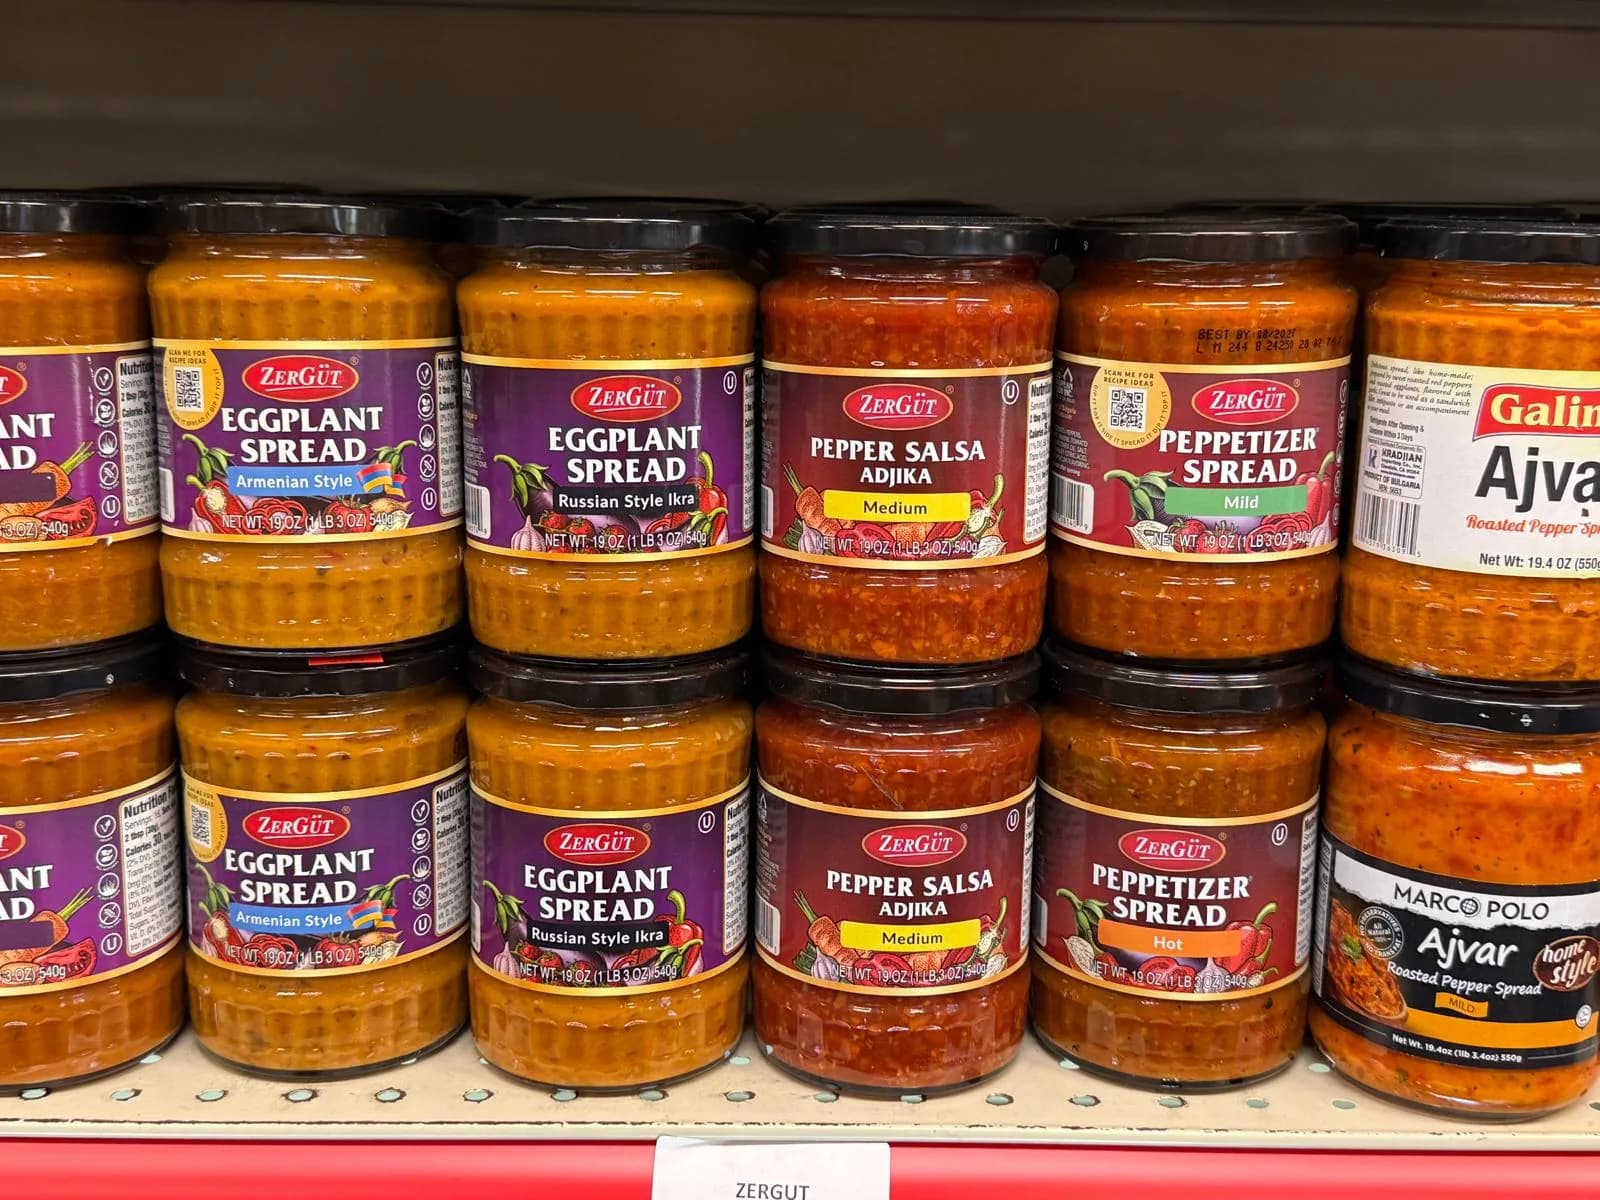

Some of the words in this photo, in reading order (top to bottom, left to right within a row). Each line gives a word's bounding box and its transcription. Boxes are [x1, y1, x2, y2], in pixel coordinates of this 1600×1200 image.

[1198, 329, 1229, 340] BEST
[1237, 330, 1250, 340] BY
[260, 364, 342, 386] ZERGÜT
[1104, 377, 1127, 385] RECIPE
[589, 384, 666, 406] ZERGÜT
[859, 393, 937, 415] ZERGÜT
[1210, 387, 1285, 409] ZERGÜT
[222, 407, 383, 433] EGGPLANT
[548, 426, 701, 452] EGGPLANT
[811, 437, 895, 462] PEPPER
[905, 440, 985, 462] SALSA
[1159, 428, 1317, 453] PEPPETIZER
[240, 438, 366, 463] SPREAD
[1382, 448, 1423, 462] KRADJIAN
[568, 457, 686, 483] SPREAD
[860, 467, 932, 488] ADJIKA
[1184, 458, 1297, 484] SPREAD
[236, 475, 312, 488] Armenian
[316, 473, 352, 490] Style
[1391, 478, 1420, 489] BULGARIA
[558, 494, 618, 508] Russian
[624, 494, 663, 511] Style
[669, 492, 695, 506] Ikra
[864, 500, 927, 514] Medium
[1224, 495, 1259, 509] Mild
[222, 515, 243, 528] NET
[246, 516, 265, 529] WT.
[269, 516, 280, 529] 19
[284, 516, 301, 529] OZ
[304, 516, 314, 530] (1
[320, 516, 334, 529] LB
[337, 516, 344, 528] 3
[347, 514, 366, 528] OZ)
[370, 512, 392, 526] 540g
[1466, 515, 1524, 532] Roasted
[1529, 520, 1578, 537] Pepper
[545, 534, 566, 547] NET
[569, 535, 589, 548] WT.
[593, 536, 605, 548] 19
[609, 536, 624, 548] OZ
[628, 535, 636, 549] (1
[641, 535, 655, 547] LB
[657, 534, 663, 546] 3
[666, 533, 684, 546] OZ)
[686, 531, 706, 545] 540g
[815, 538, 835, 551] NET
[838, 540, 854, 552] WT.
[859, 541, 870, 553] 19
[874, 541, 889, 553] OZ
[892, 541, 902, 555] (1
[907, 541, 919, 553] LB
[922, 541, 930, 553] 3
[932, 540, 952, 554] OZ)
[955, 541, 977, 554] 540g
[1154, 533, 1175, 545] NET
[1180, 534, 1198, 547] WT.
[1204, 535, 1216, 547] 19
[1219, 535, 1234, 548] OZ
[1238, 535, 1246, 549] (1
[1251, 534, 1263, 547] LB
[1265, 533, 1272, 545] 3
[1275, 532, 1292, 545] OZ)
[1480, 553, 1500, 566] Net
[1504, 555, 1524, 568] Wt:
[1529, 557, 1552, 569] 19.4
[1556, 557, 1571, 569] OZ
[124, 791, 167, 819] Nutrition
[258, 814, 333, 835] ZERGÜT
[560, 831, 634, 850] ZERGÜT
[879, 832, 952, 852] ZERGÜT
[1135, 837, 1210, 858] ZERGÜT
[225, 848, 374, 876] EGGPLANT
[524, 864, 672, 894] EGGPLANT
[827, 870, 913, 897] PEPPER
[924, 869, 993, 895] SALSA
[1092, 864, 1249, 900] PEPPETIZER
[240, 879, 356, 905] SPREAD
[236, 911, 300, 927] Armenian
[305, 913, 342, 928] Style
[540, 897, 654, 922] SPREAD
[879, 901, 947, 920] ADJIKA
[1113, 896, 1226, 927] SPREAD
[1487, 901, 1549, 920] POLO
[532, 928, 586, 944] Russian
[592, 929, 629, 947] Style
[636, 927, 663, 942] Ikra
[882, 932, 943, 945] Medium
[1154, 936, 1183, 951] Hot
[224, 943, 241, 957] NET
[244, 948, 260, 962] WT.
[263, 951, 275, 963] 19
[278, 951, 293, 963] OZ
[296, 951, 304, 964] (1
[309, 950, 323, 963] LB
[326, 950, 333, 962] 3
[336, 948, 355, 962] OZ)
[358, 945, 383, 959] 540g
[1417, 928, 1518, 968] Ajvar
[1542, 939, 1585, 962] home
[520, 963, 538, 976] NET
[540, 967, 558, 980] WT.
[561, 969, 572, 981] 19
[576, 970, 590, 983] OZ
[594, 969, 602, 983] (1
[607, 969, 620, 981] LB
[624, 968, 630, 980] 3
[633, 967, 650, 980] OZ)
[654, 965, 676, 978] 540g
[832, 965, 852, 977] NET
[855, 968, 872, 980] WT.
[878, 969, 888, 981] 19
[892, 970, 907, 982] OZ
[910, 970, 920, 983] (1
[923, 970, 936, 982] LB
[939, 969, 945, 981] 3
[947, 967, 964, 981] OZ)
[967, 966, 986, 977] 540g
[1089, 959, 1108, 975] NET
[1111, 966, 1128, 979] WT.
[1132, 971, 1144, 982] 19
[1147, 972, 1162, 985] OZ
[1165, 972, 1173, 987] (1
[1178, 975, 1191, 987] LB
[1195, 975, 1201, 987] 3
[1204, 975, 1223, 988] OZ)
[1225, 974, 1247, 987] 540g
[1387, 962, 1438, 985] Roasted
[1442, 974, 1491, 994] Pepper
[1495, 982, 1543, 999] Spread
[1551, 953, 1598, 989] style
[1449, 997, 1474, 1012] MILD
[1392, 1034, 1407, 1047] Net
[1408, 1038, 1423, 1050] Wt.
[1425, 1043, 1452, 1056] 19.4oz
[1471, 1049, 1499, 1062] 3.4oz)
[1501, 1053, 1522, 1063] 550g
[736, 1183, 809, 1200] ZERGUT
